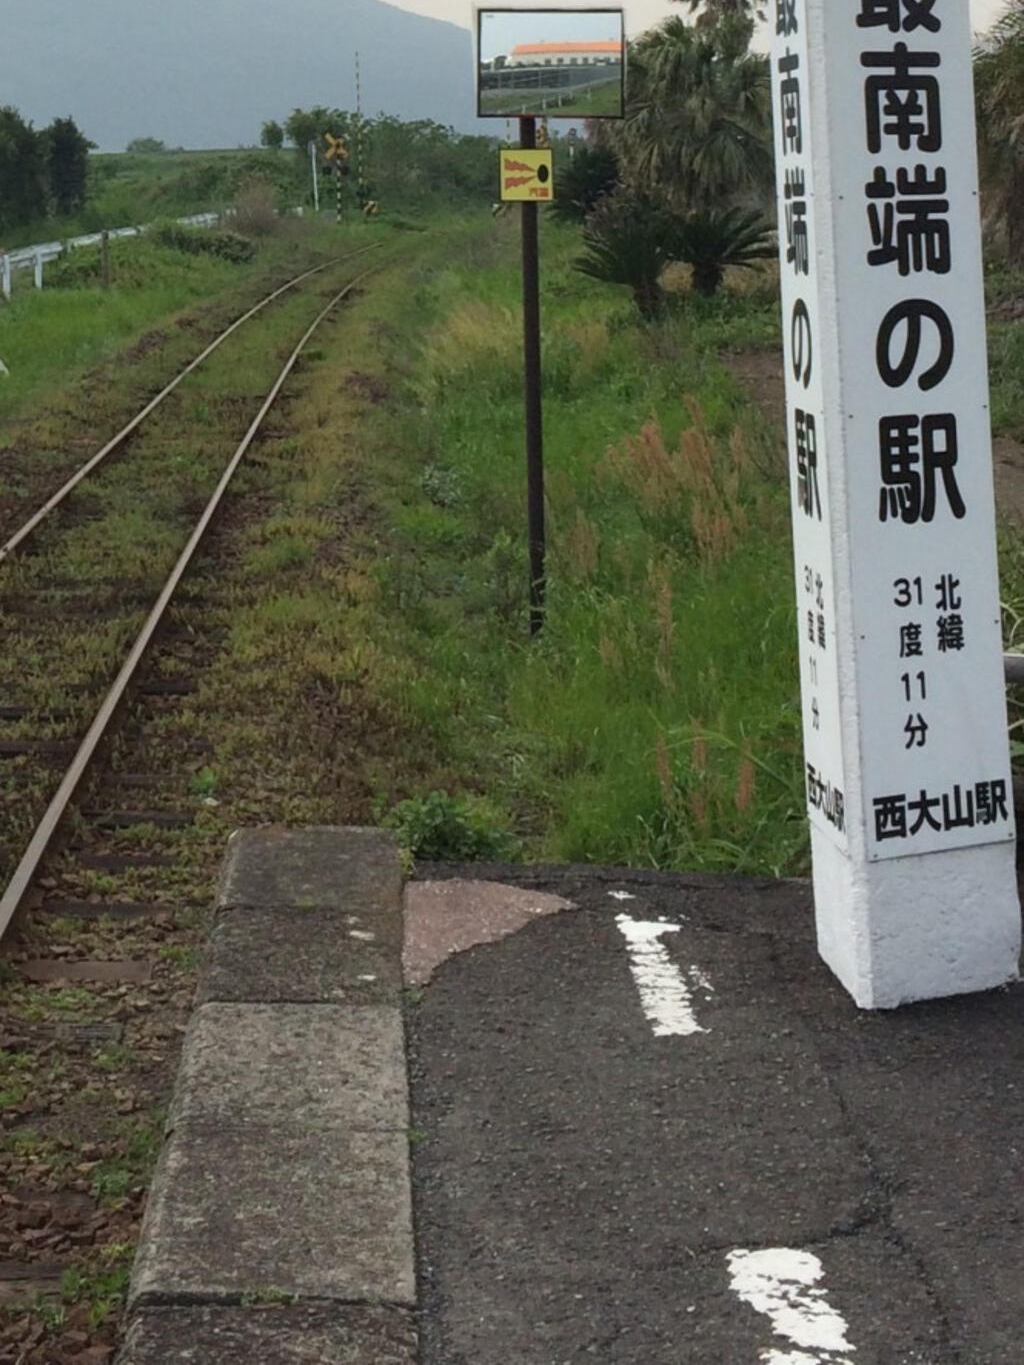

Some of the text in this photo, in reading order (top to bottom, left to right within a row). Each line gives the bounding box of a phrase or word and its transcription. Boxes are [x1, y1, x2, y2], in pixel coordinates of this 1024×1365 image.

[935, 574, 965, 652] 北緯
[893, 576, 930, 749] 31度11分
[873, 779, 1009, 842] 西大山駅
